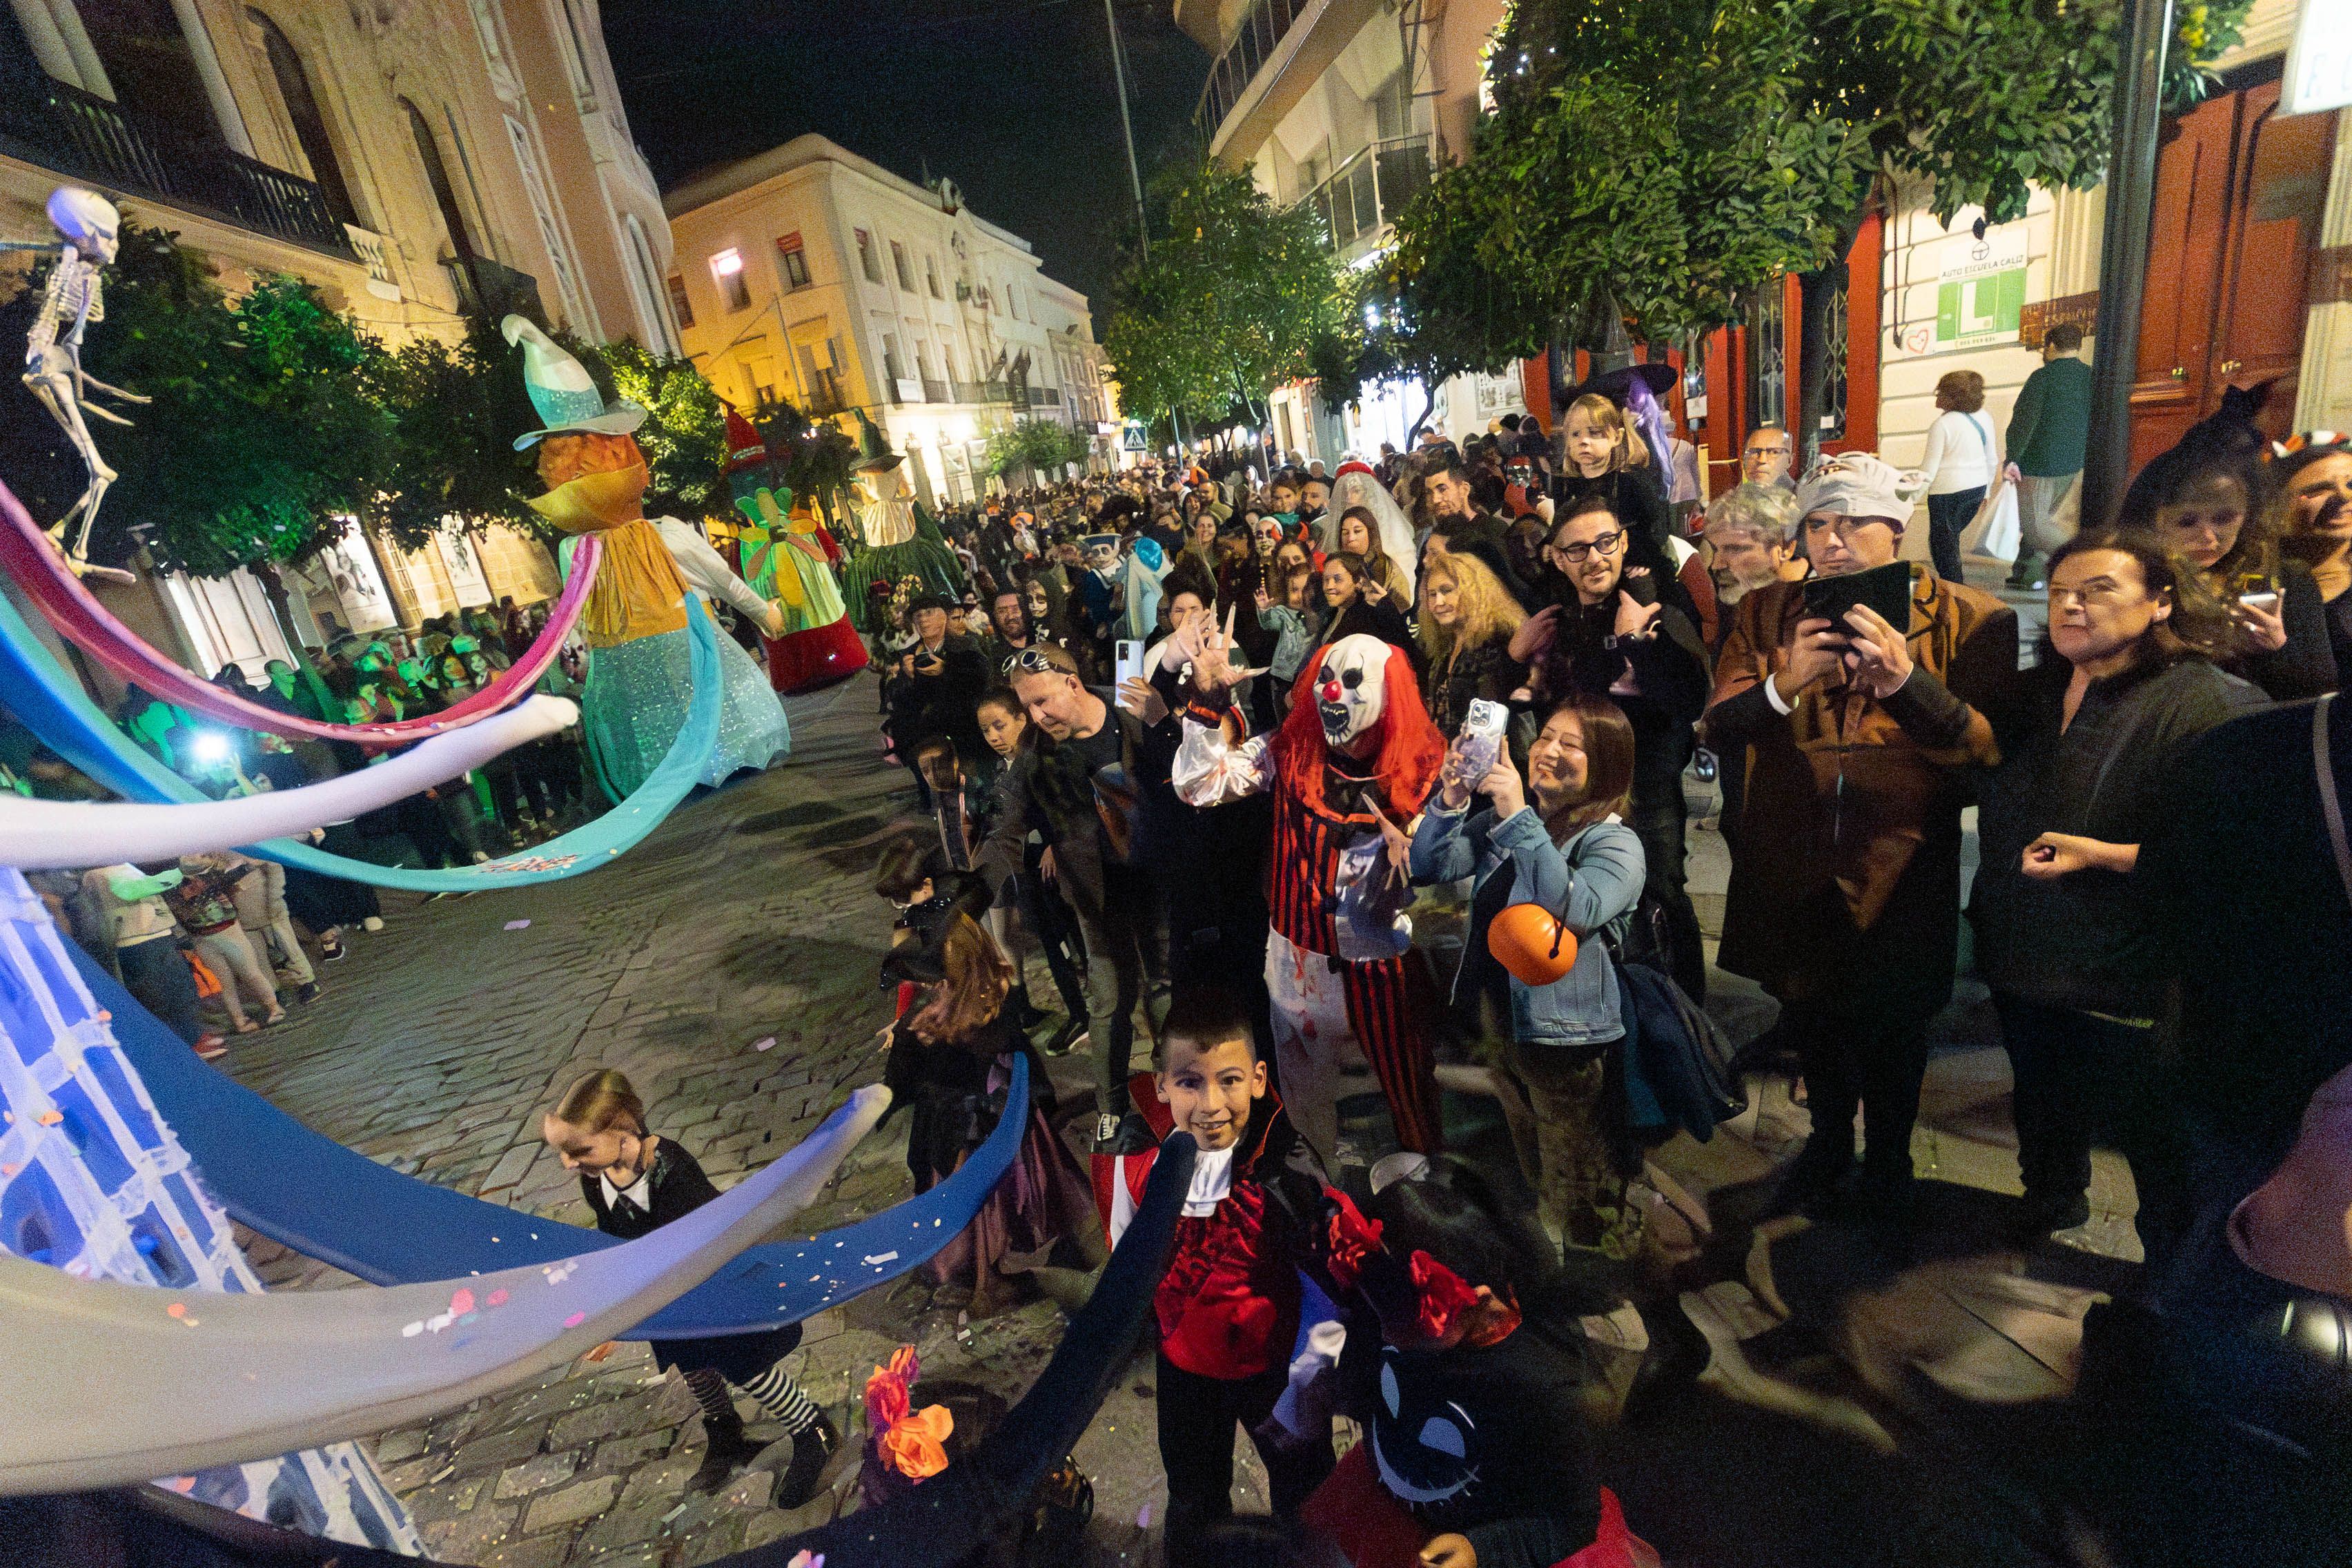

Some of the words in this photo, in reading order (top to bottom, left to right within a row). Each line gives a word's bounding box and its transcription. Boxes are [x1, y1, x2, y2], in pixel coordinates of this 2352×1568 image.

[1942, 268, 1962, 277] AUTO
[1965, 261, 1998, 273] ESCUELA
[1960, 281, 1994, 333] L
